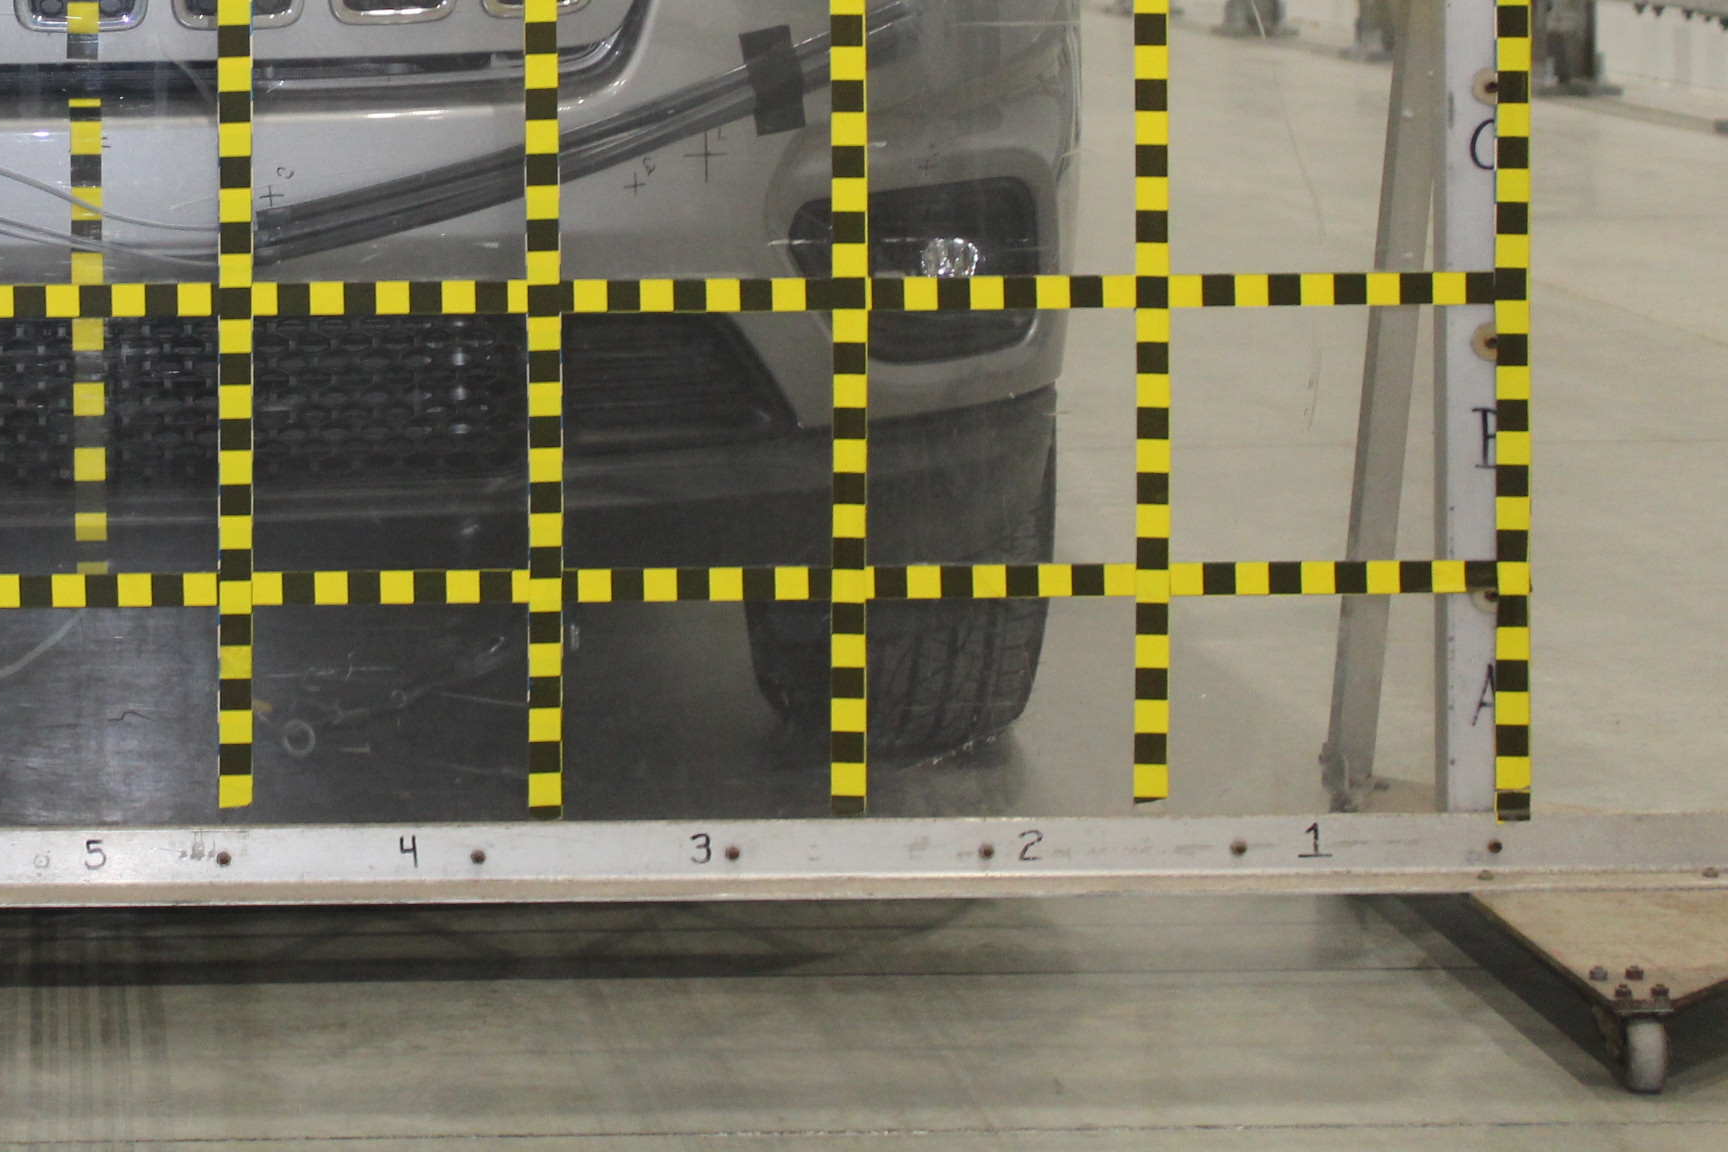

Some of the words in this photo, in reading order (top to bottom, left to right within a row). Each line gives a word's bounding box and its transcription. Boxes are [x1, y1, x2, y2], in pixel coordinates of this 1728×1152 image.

[84, 838, 107, 871] 5
[399, 834, 419, 869] 4
[689, 832, 712, 865] 3
[1018, 829, 1043, 862] 2
[1297, 822, 1333, 859] 1
